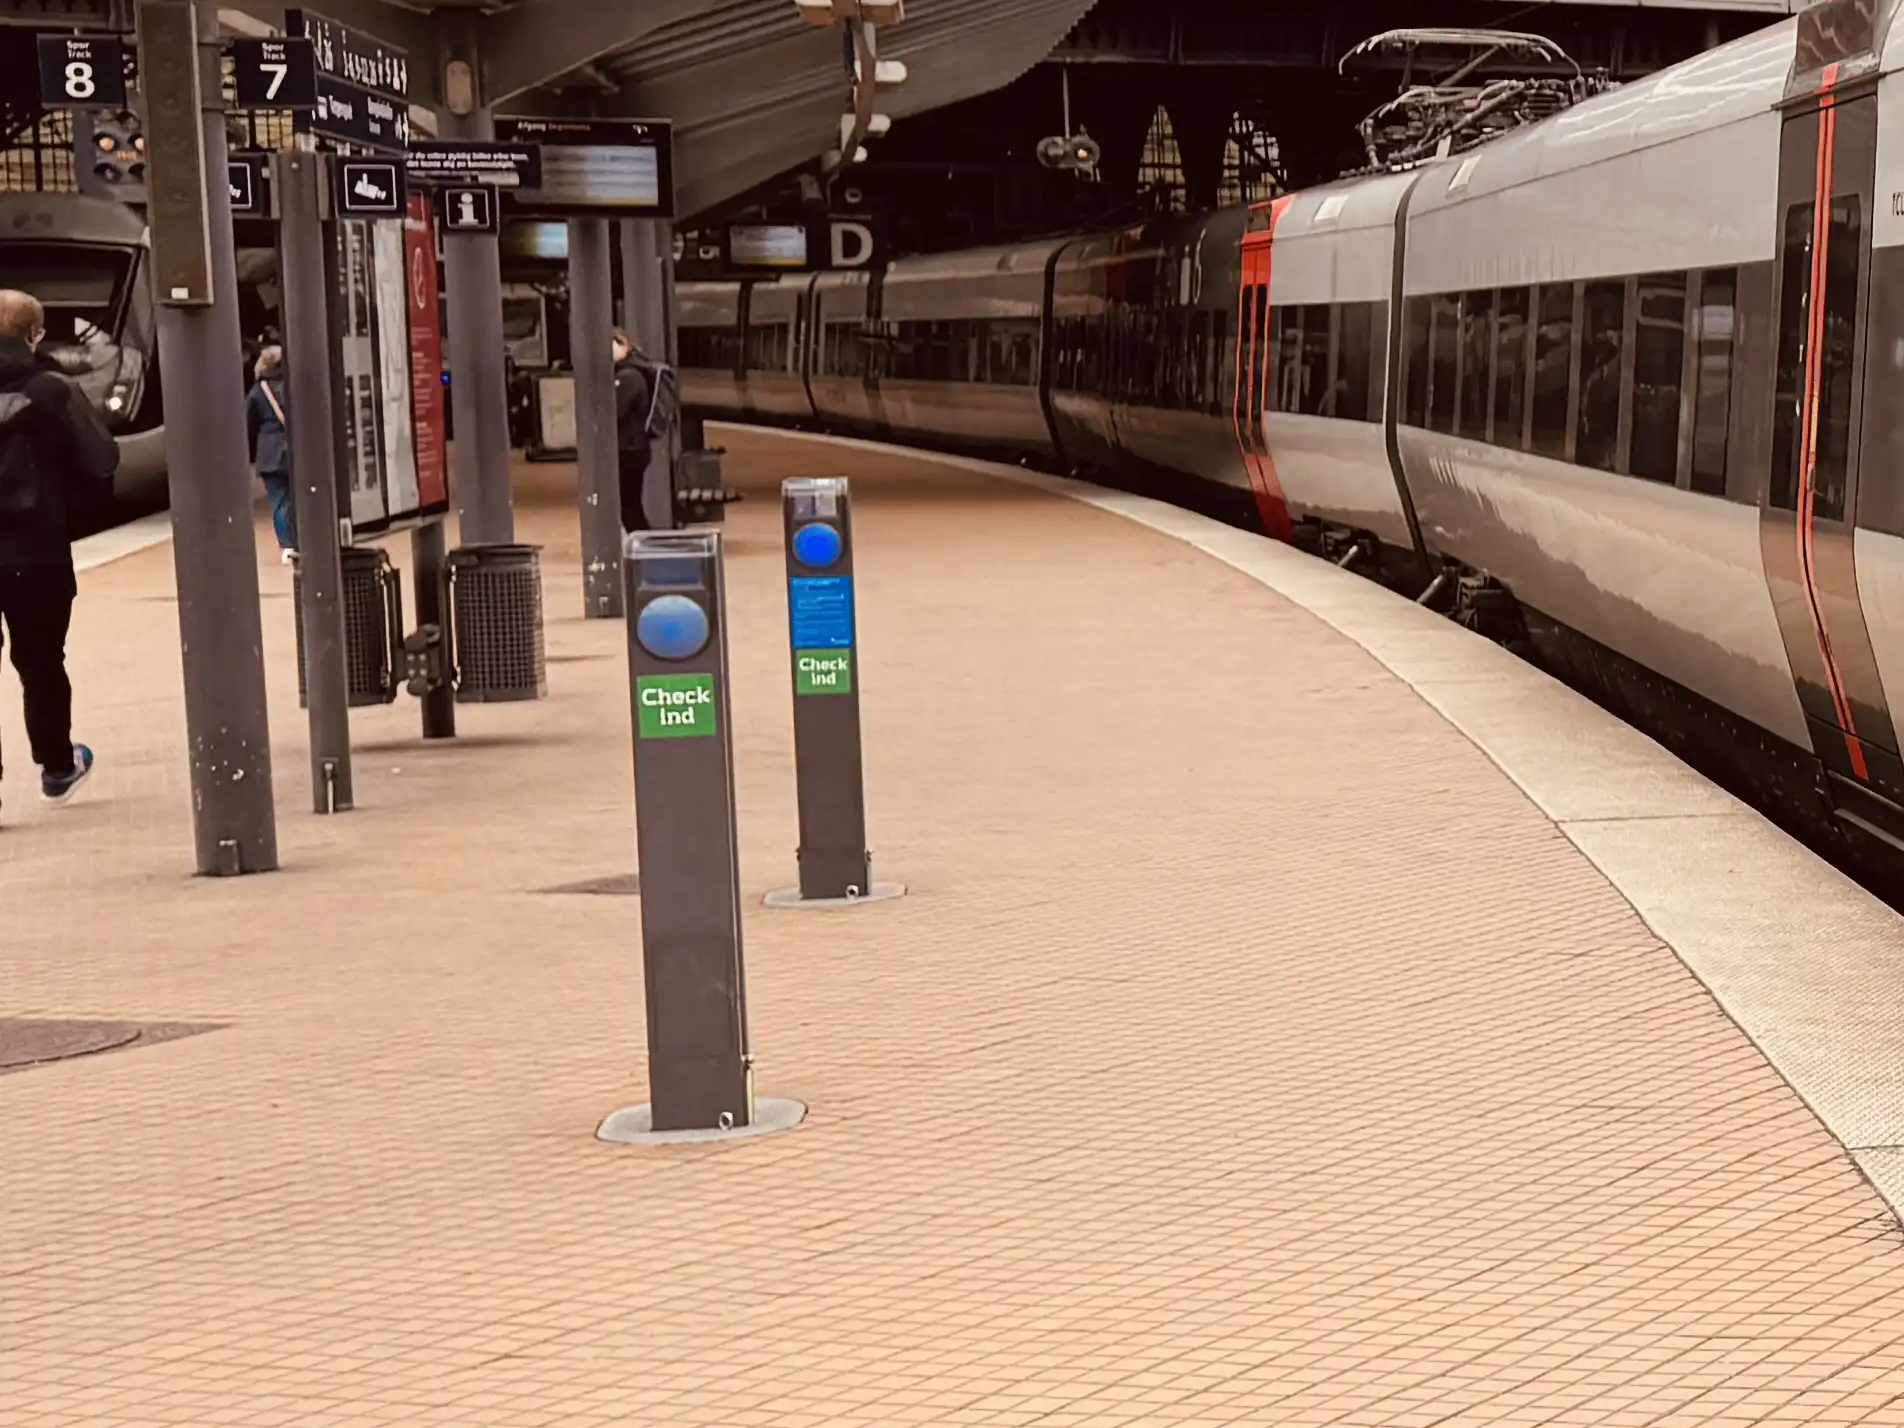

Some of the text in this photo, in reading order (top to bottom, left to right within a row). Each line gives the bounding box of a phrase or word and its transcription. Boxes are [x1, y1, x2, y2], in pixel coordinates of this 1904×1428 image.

[65, 61, 95, 98] 8
[260, 63, 287, 100] 7
[831, 223, 874, 267] D
[799, 656, 848, 671] Check
[811, 672, 836, 685] Ind
[641, 687, 711, 706] Check
[660, 707, 695, 725] Ind
